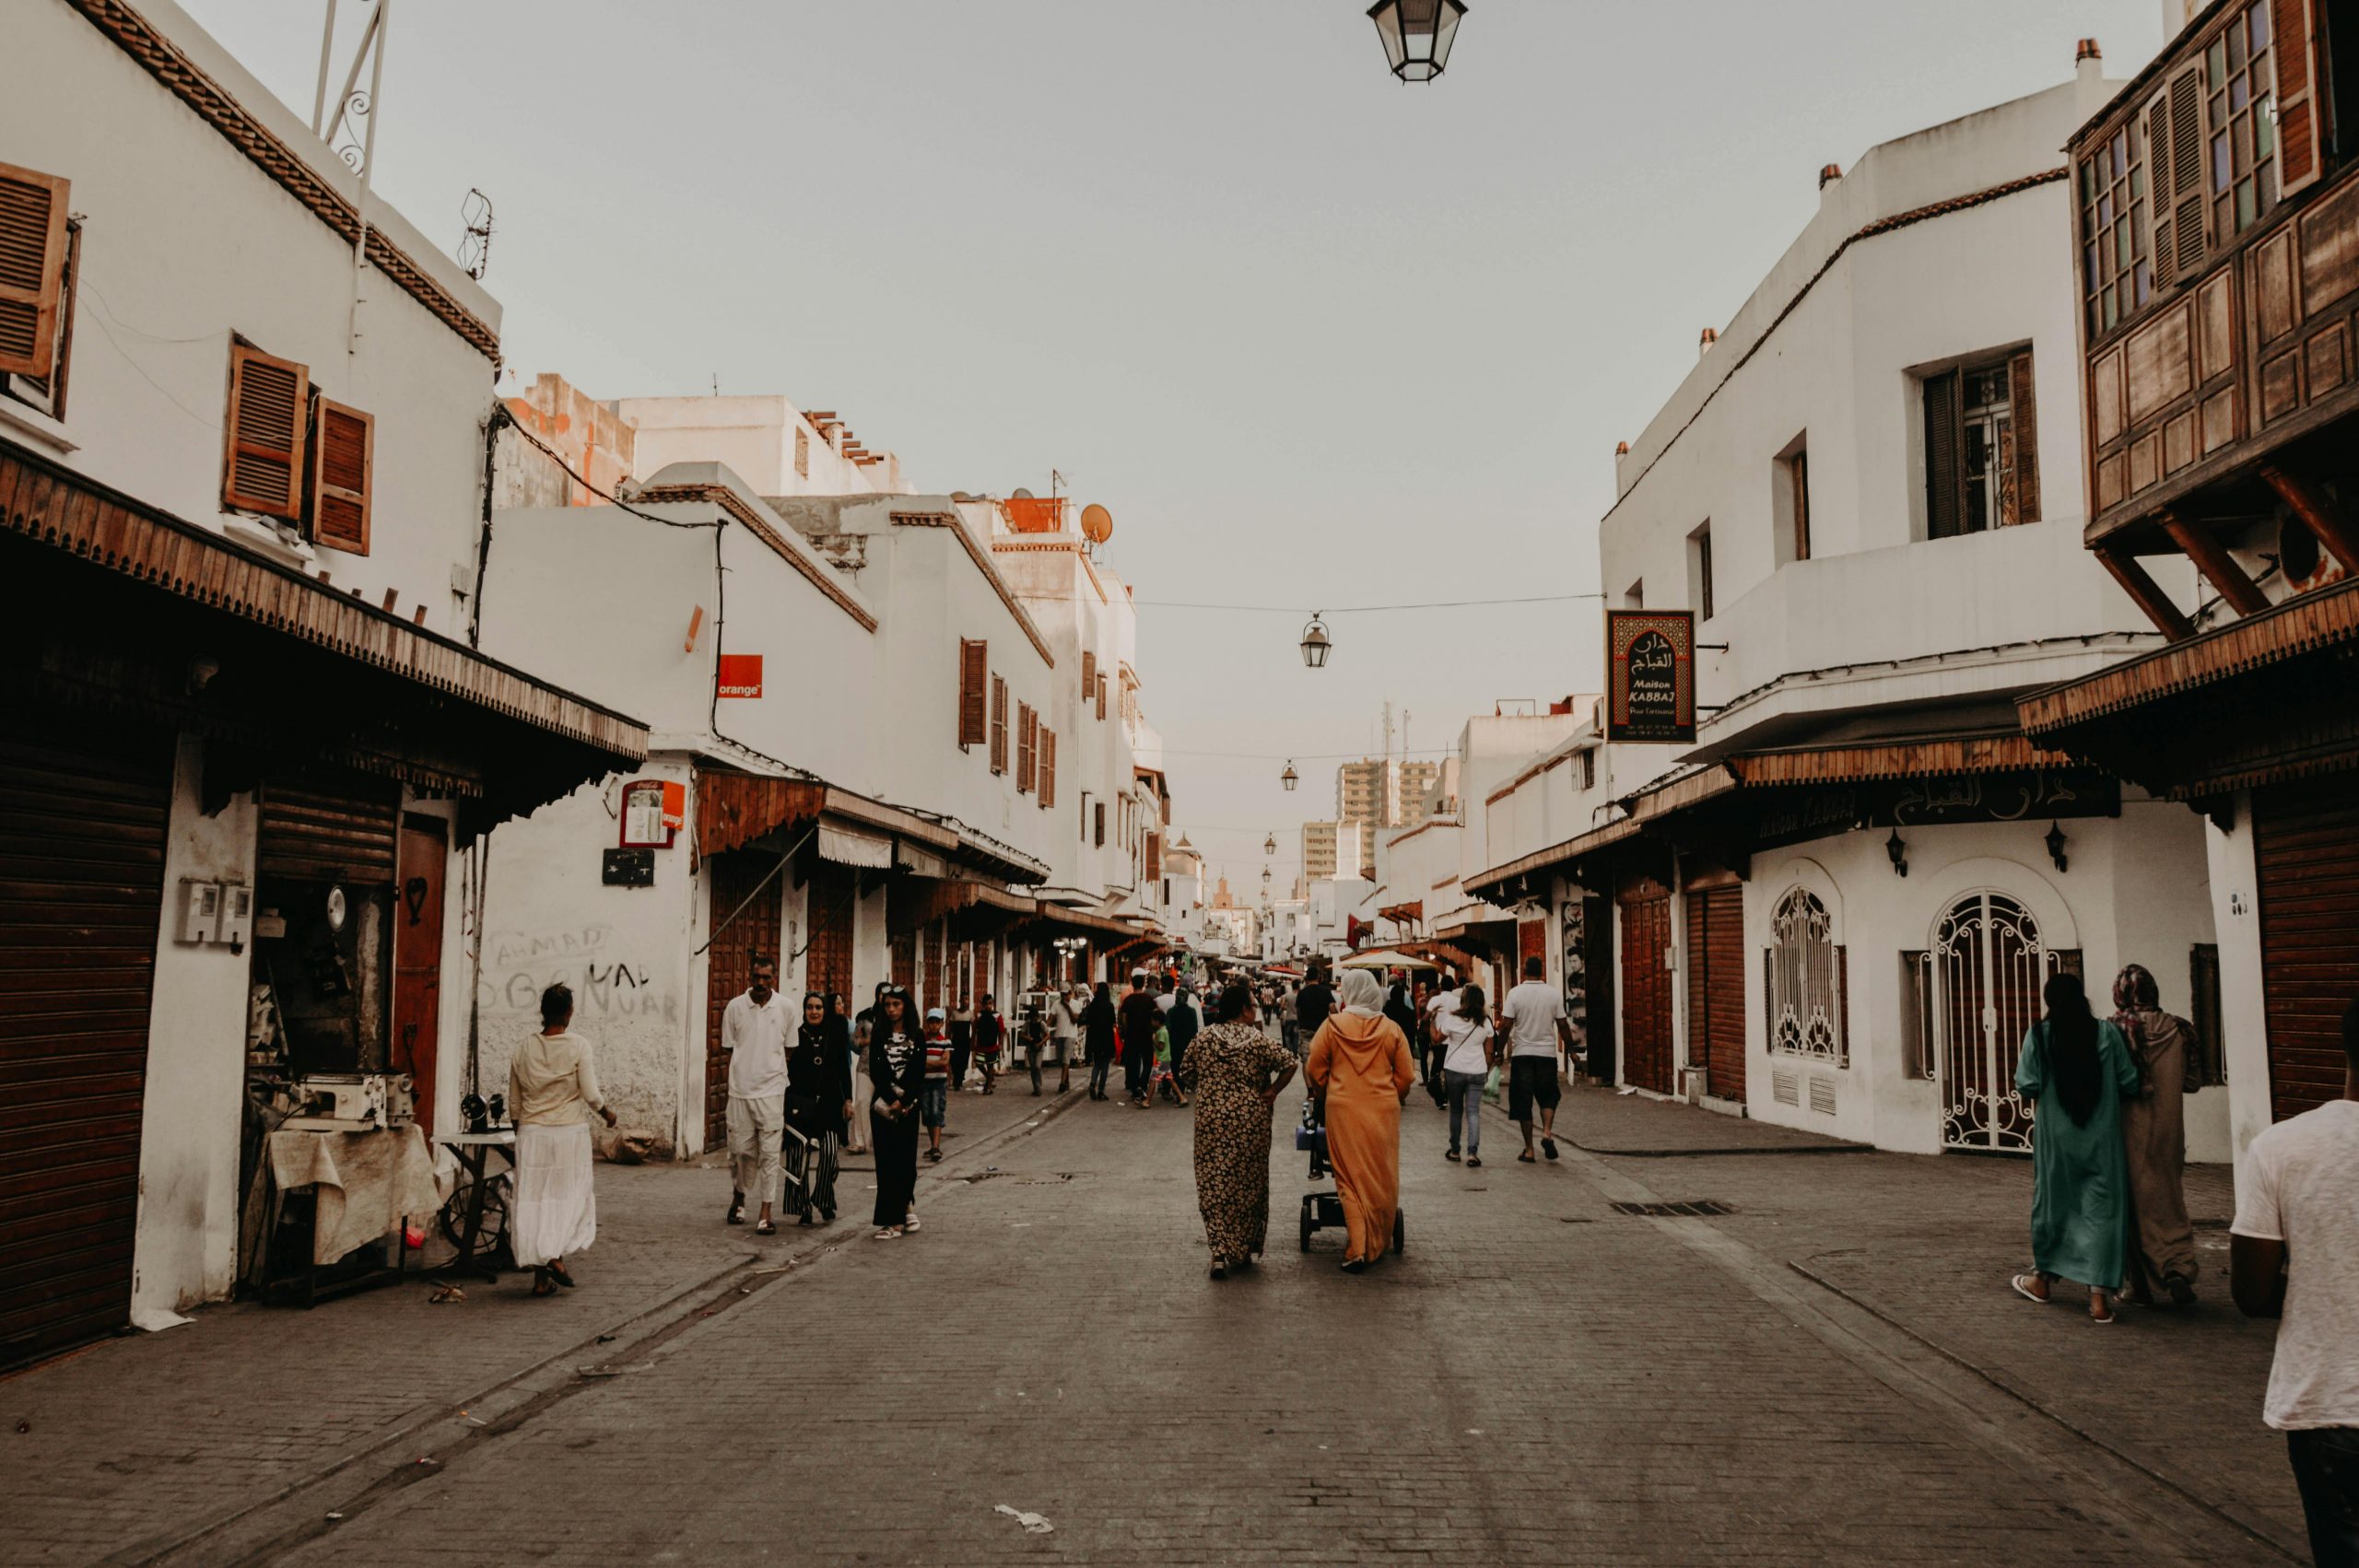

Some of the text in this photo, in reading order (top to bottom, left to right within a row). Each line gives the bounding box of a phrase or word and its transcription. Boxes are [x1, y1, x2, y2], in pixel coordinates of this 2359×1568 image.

[1635, 633, 1669, 653] دار
[1631, 653, 1672, 675] القباج
[720, 685, 758, 697] orange
[1634, 680, 1671, 689] Maison
[1628, 692, 1675, 703] KABBAJ
[1989, 772, 2076, 820] دار
